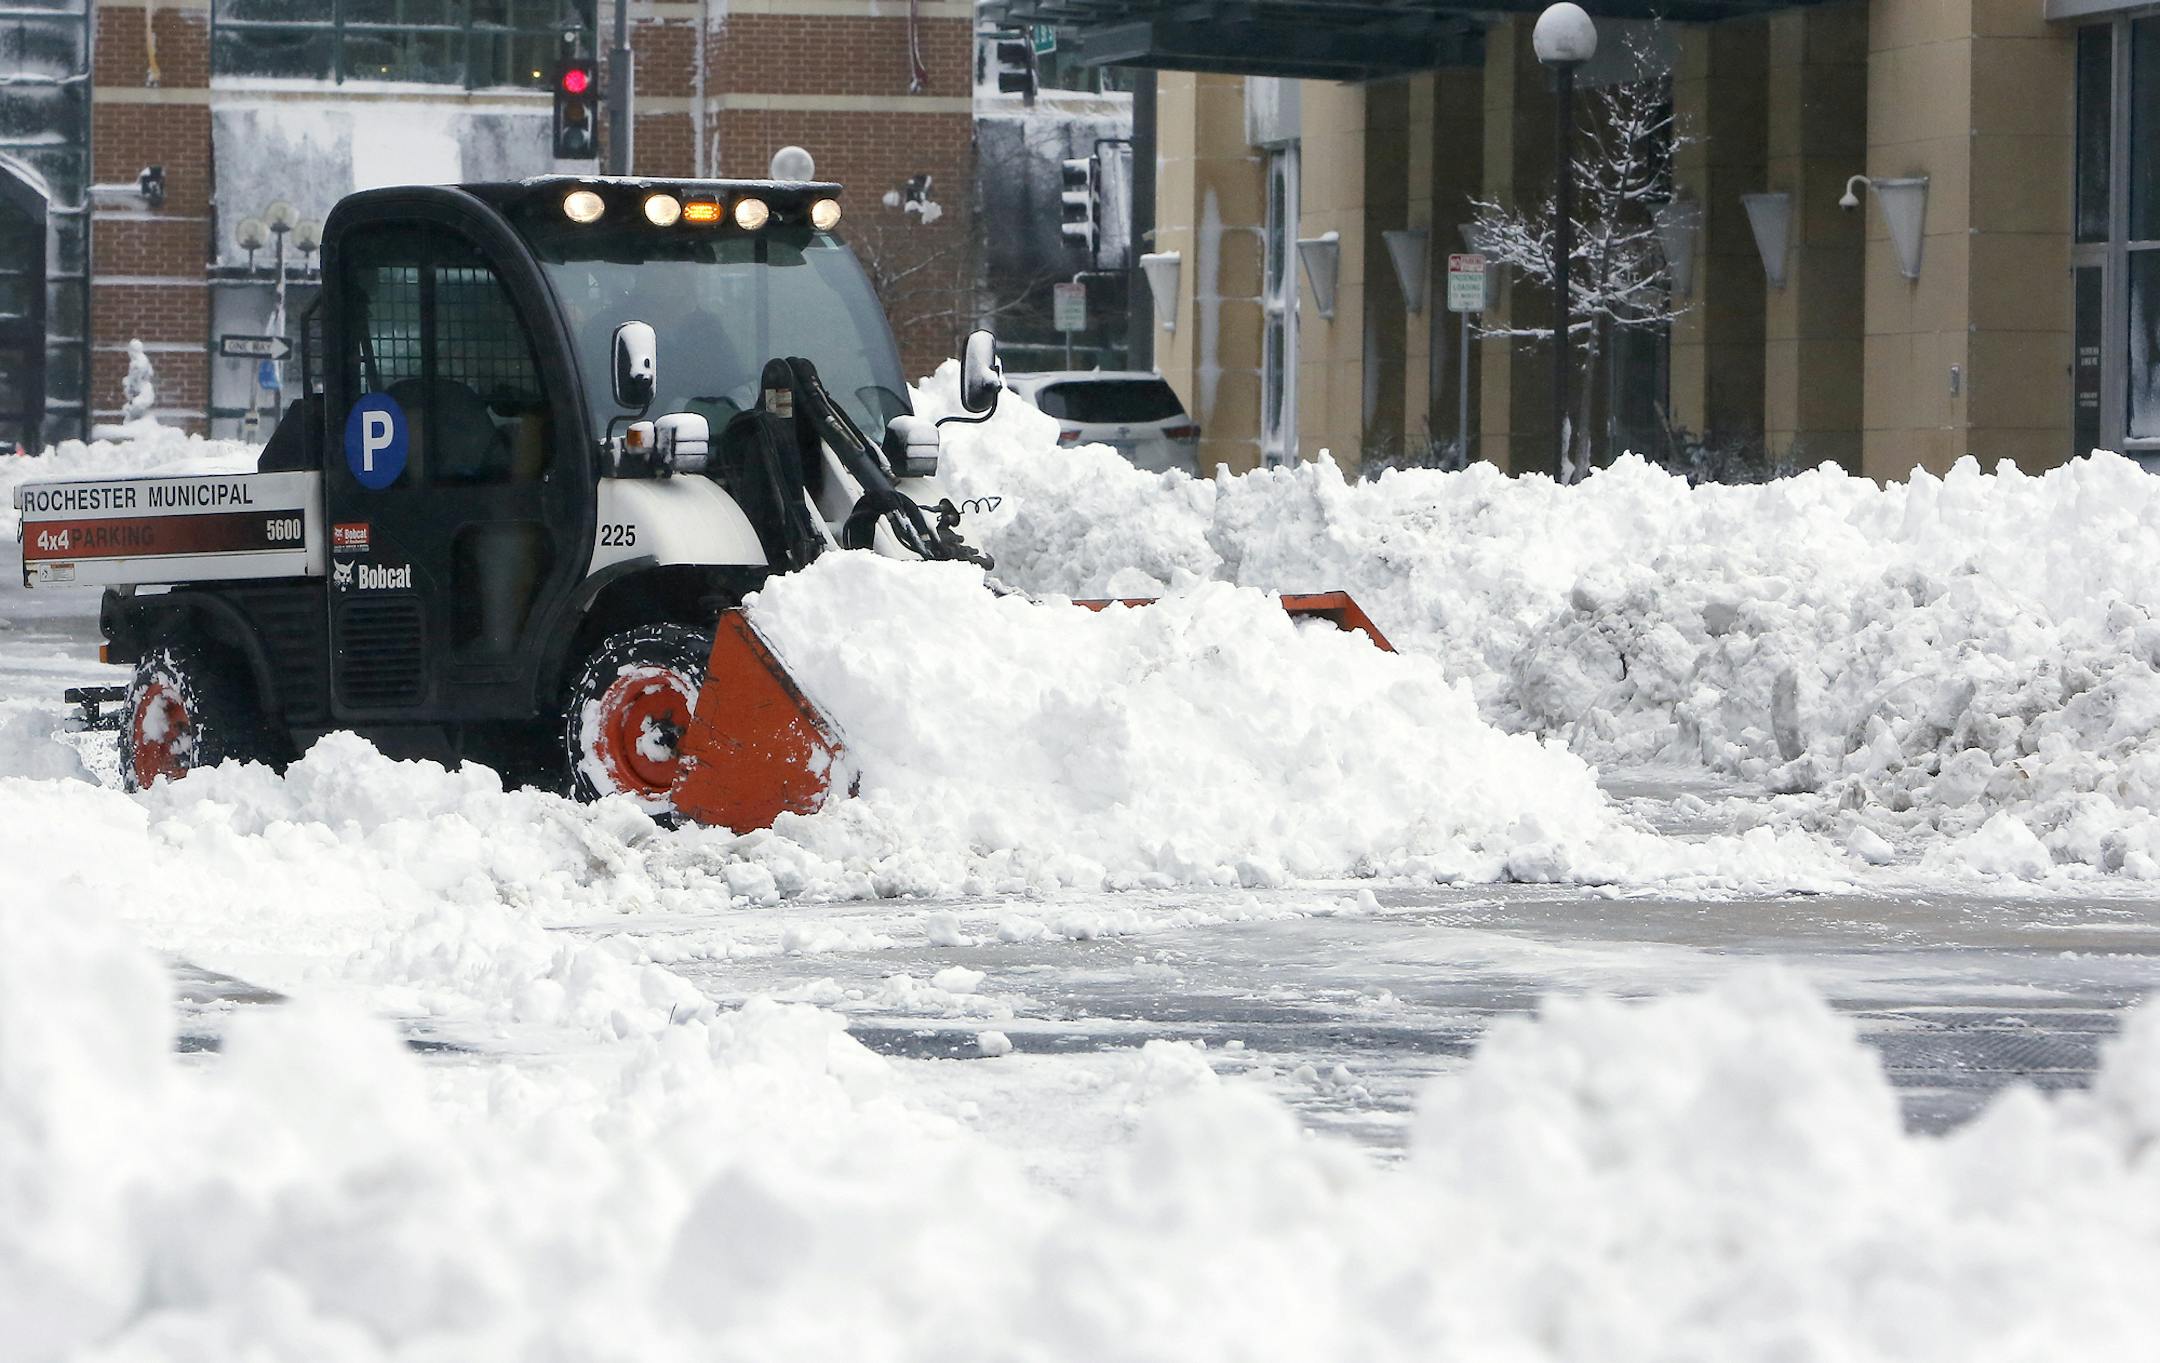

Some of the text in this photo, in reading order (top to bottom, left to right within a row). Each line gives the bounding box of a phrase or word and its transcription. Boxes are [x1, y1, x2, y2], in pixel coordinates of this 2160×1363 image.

[229, 341, 271, 352] ONE WAY
[362, 410, 395, 472] P
[24, 483, 253, 512] ROCHESTER MUNICIPAL
[37, 525, 155, 551] 4x4 PARKING
[266, 518, 301, 541] 5600
[344, 528, 367, 540] Bobcat
[600, 524, 636, 547] 225
[358, 563, 412, 590] Bobcat
